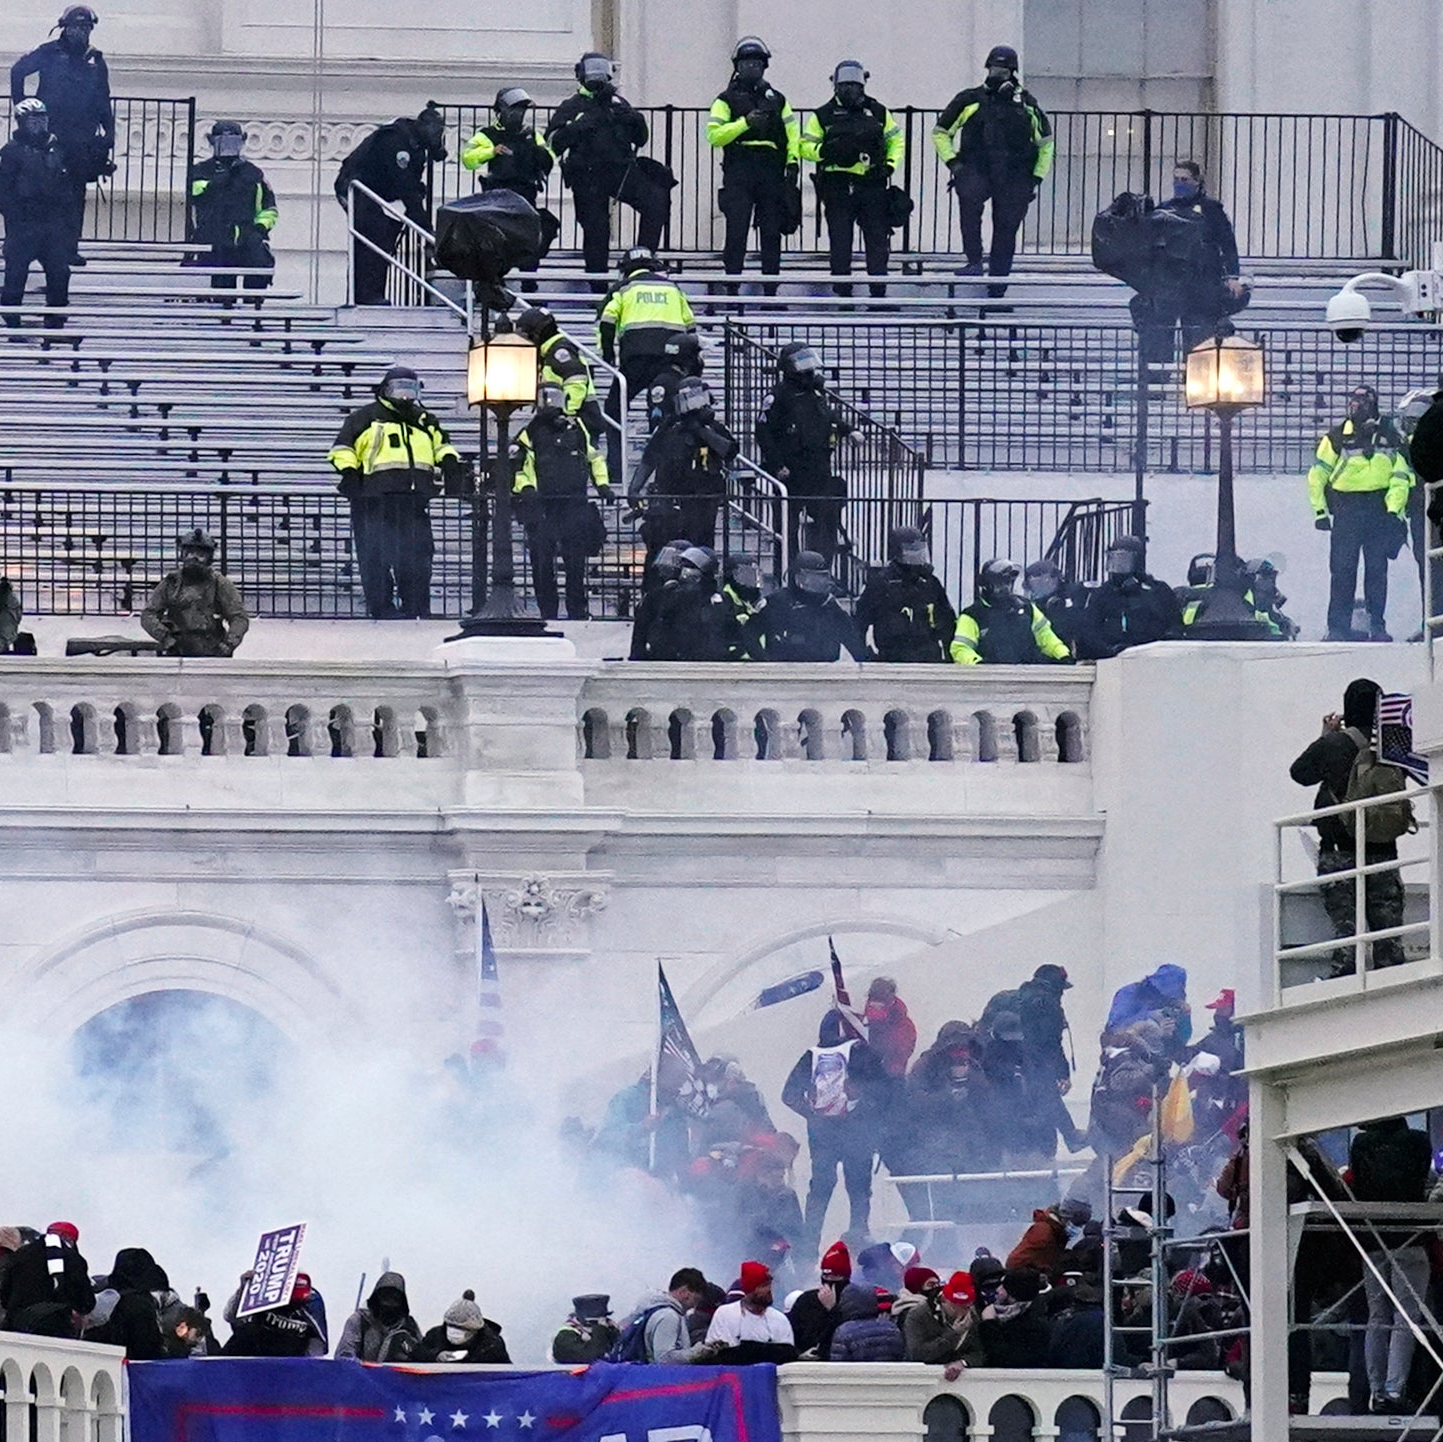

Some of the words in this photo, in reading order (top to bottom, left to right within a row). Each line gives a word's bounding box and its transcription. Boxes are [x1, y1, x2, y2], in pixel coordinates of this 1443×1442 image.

[636, 290, 669, 305] POLICE
[249, 1250, 270, 1295] 2020
[264, 1229, 297, 1303] TRUMP
